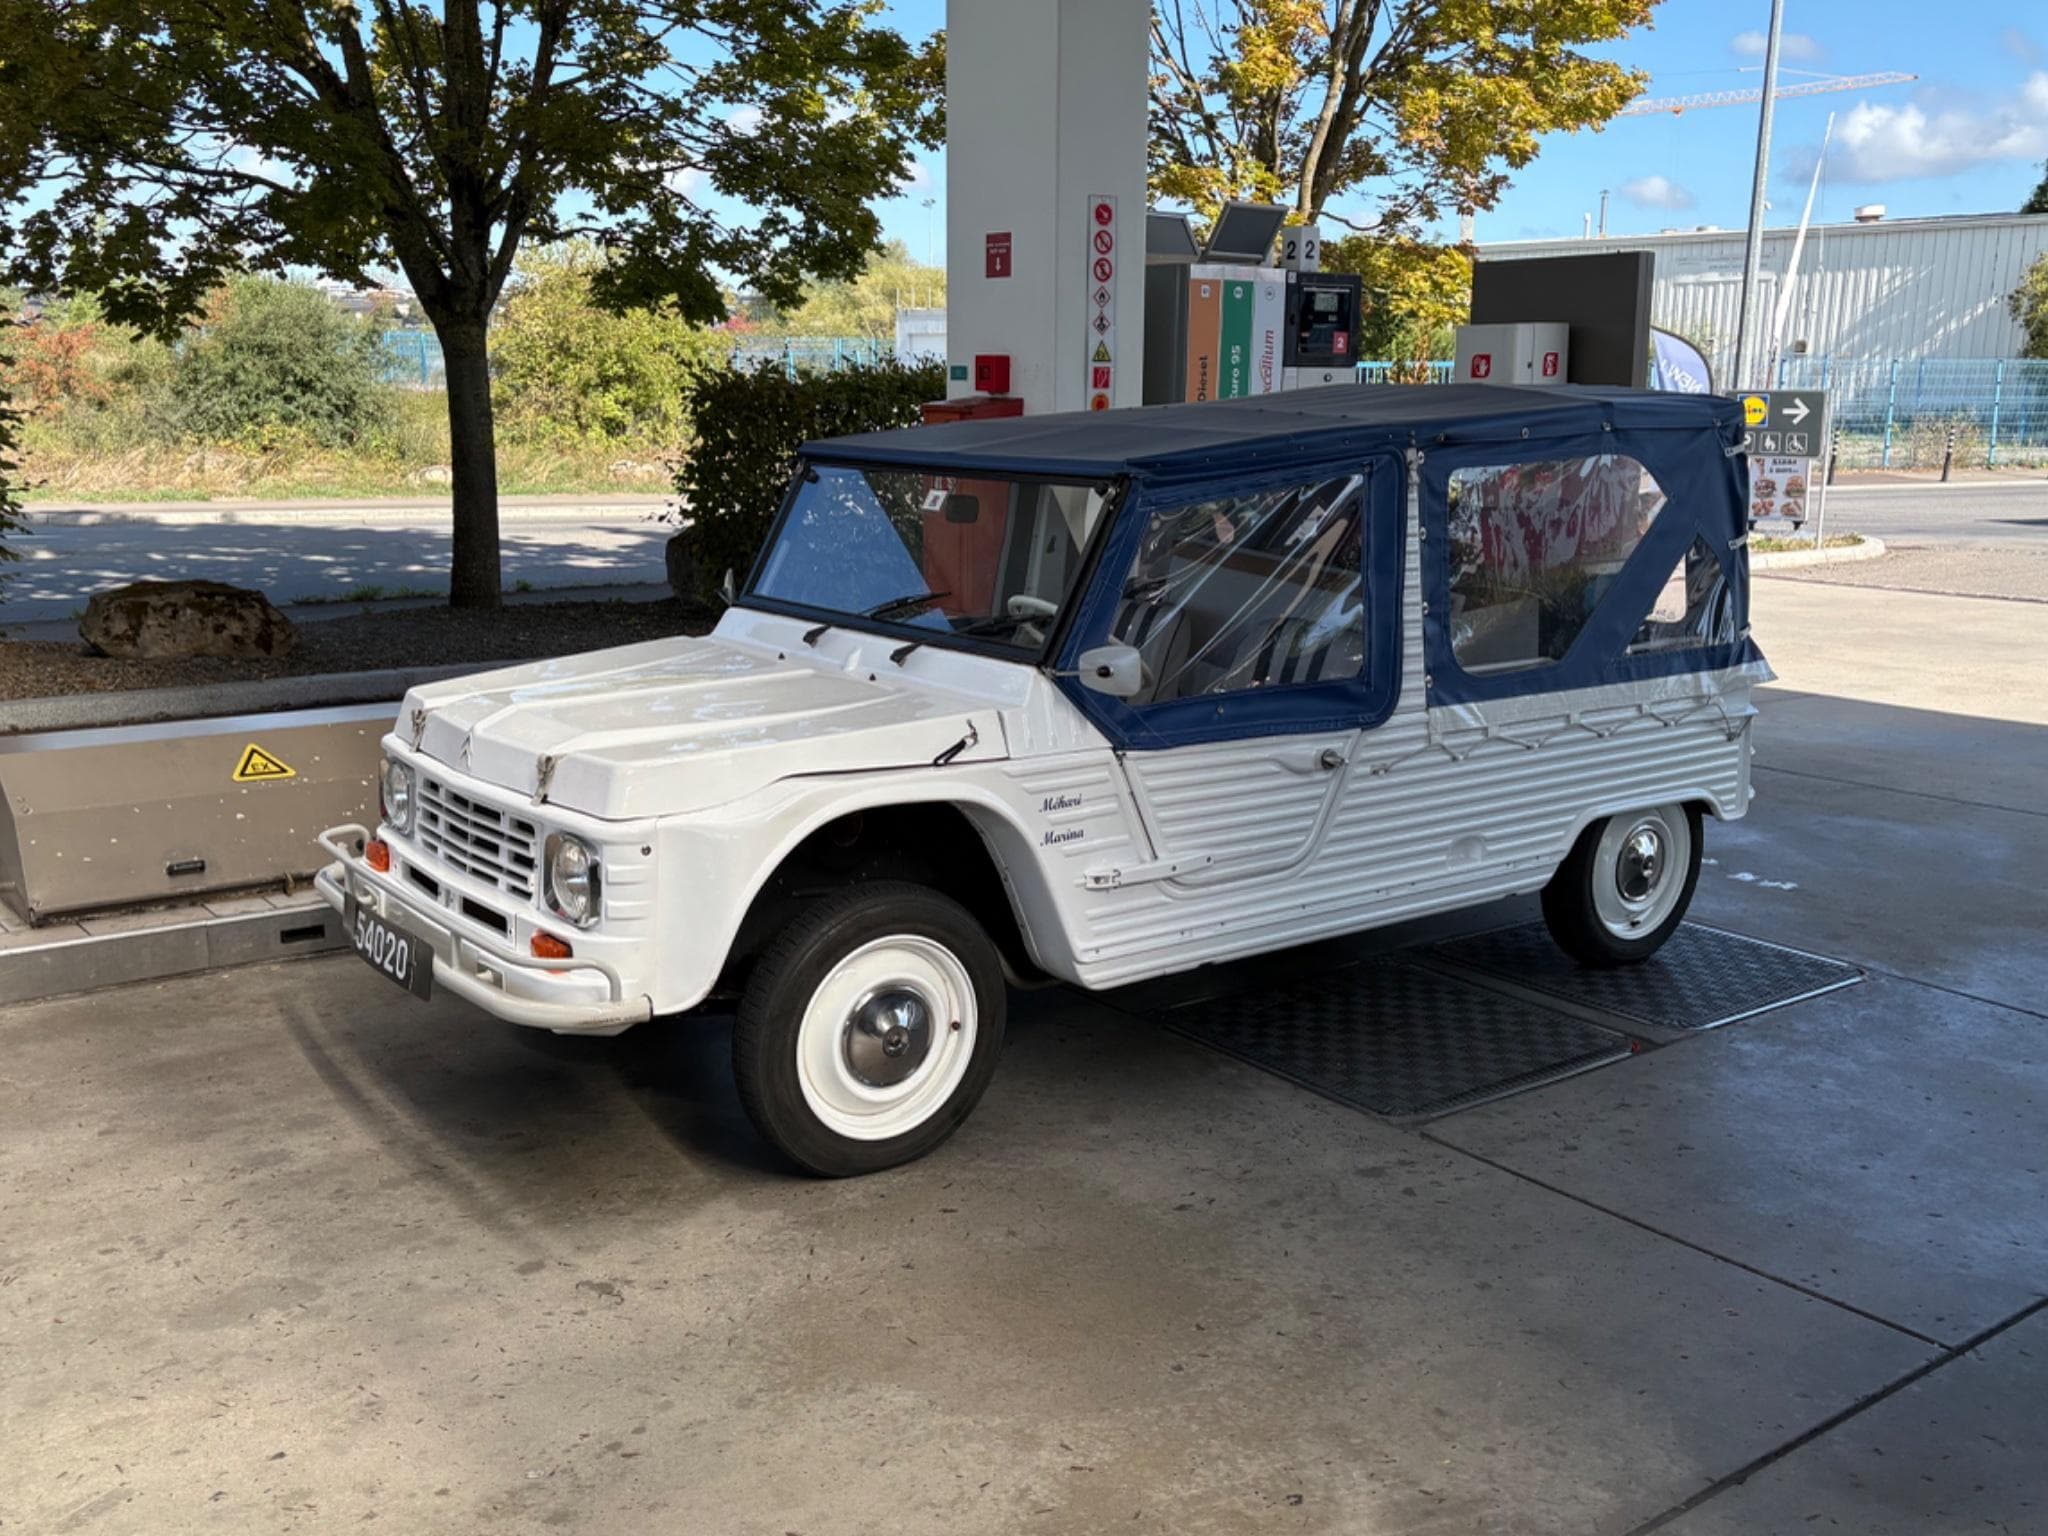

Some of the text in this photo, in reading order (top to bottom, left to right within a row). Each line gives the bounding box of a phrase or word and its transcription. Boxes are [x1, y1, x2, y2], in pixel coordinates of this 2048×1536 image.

[1286, 240, 1297, 260] 2
[1305, 240, 1315, 259] 2
[1336, 337, 1345, 349] 2
[1231, 345, 1241, 365] 95
[1260, 330, 1274, 395] xcellium
[1197, 354, 1208, 402] Diesel
[251, 762, 269, 771] EX
[1040, 828, 1084, 846] Marina
[354, 909, 408, 980] 54020
